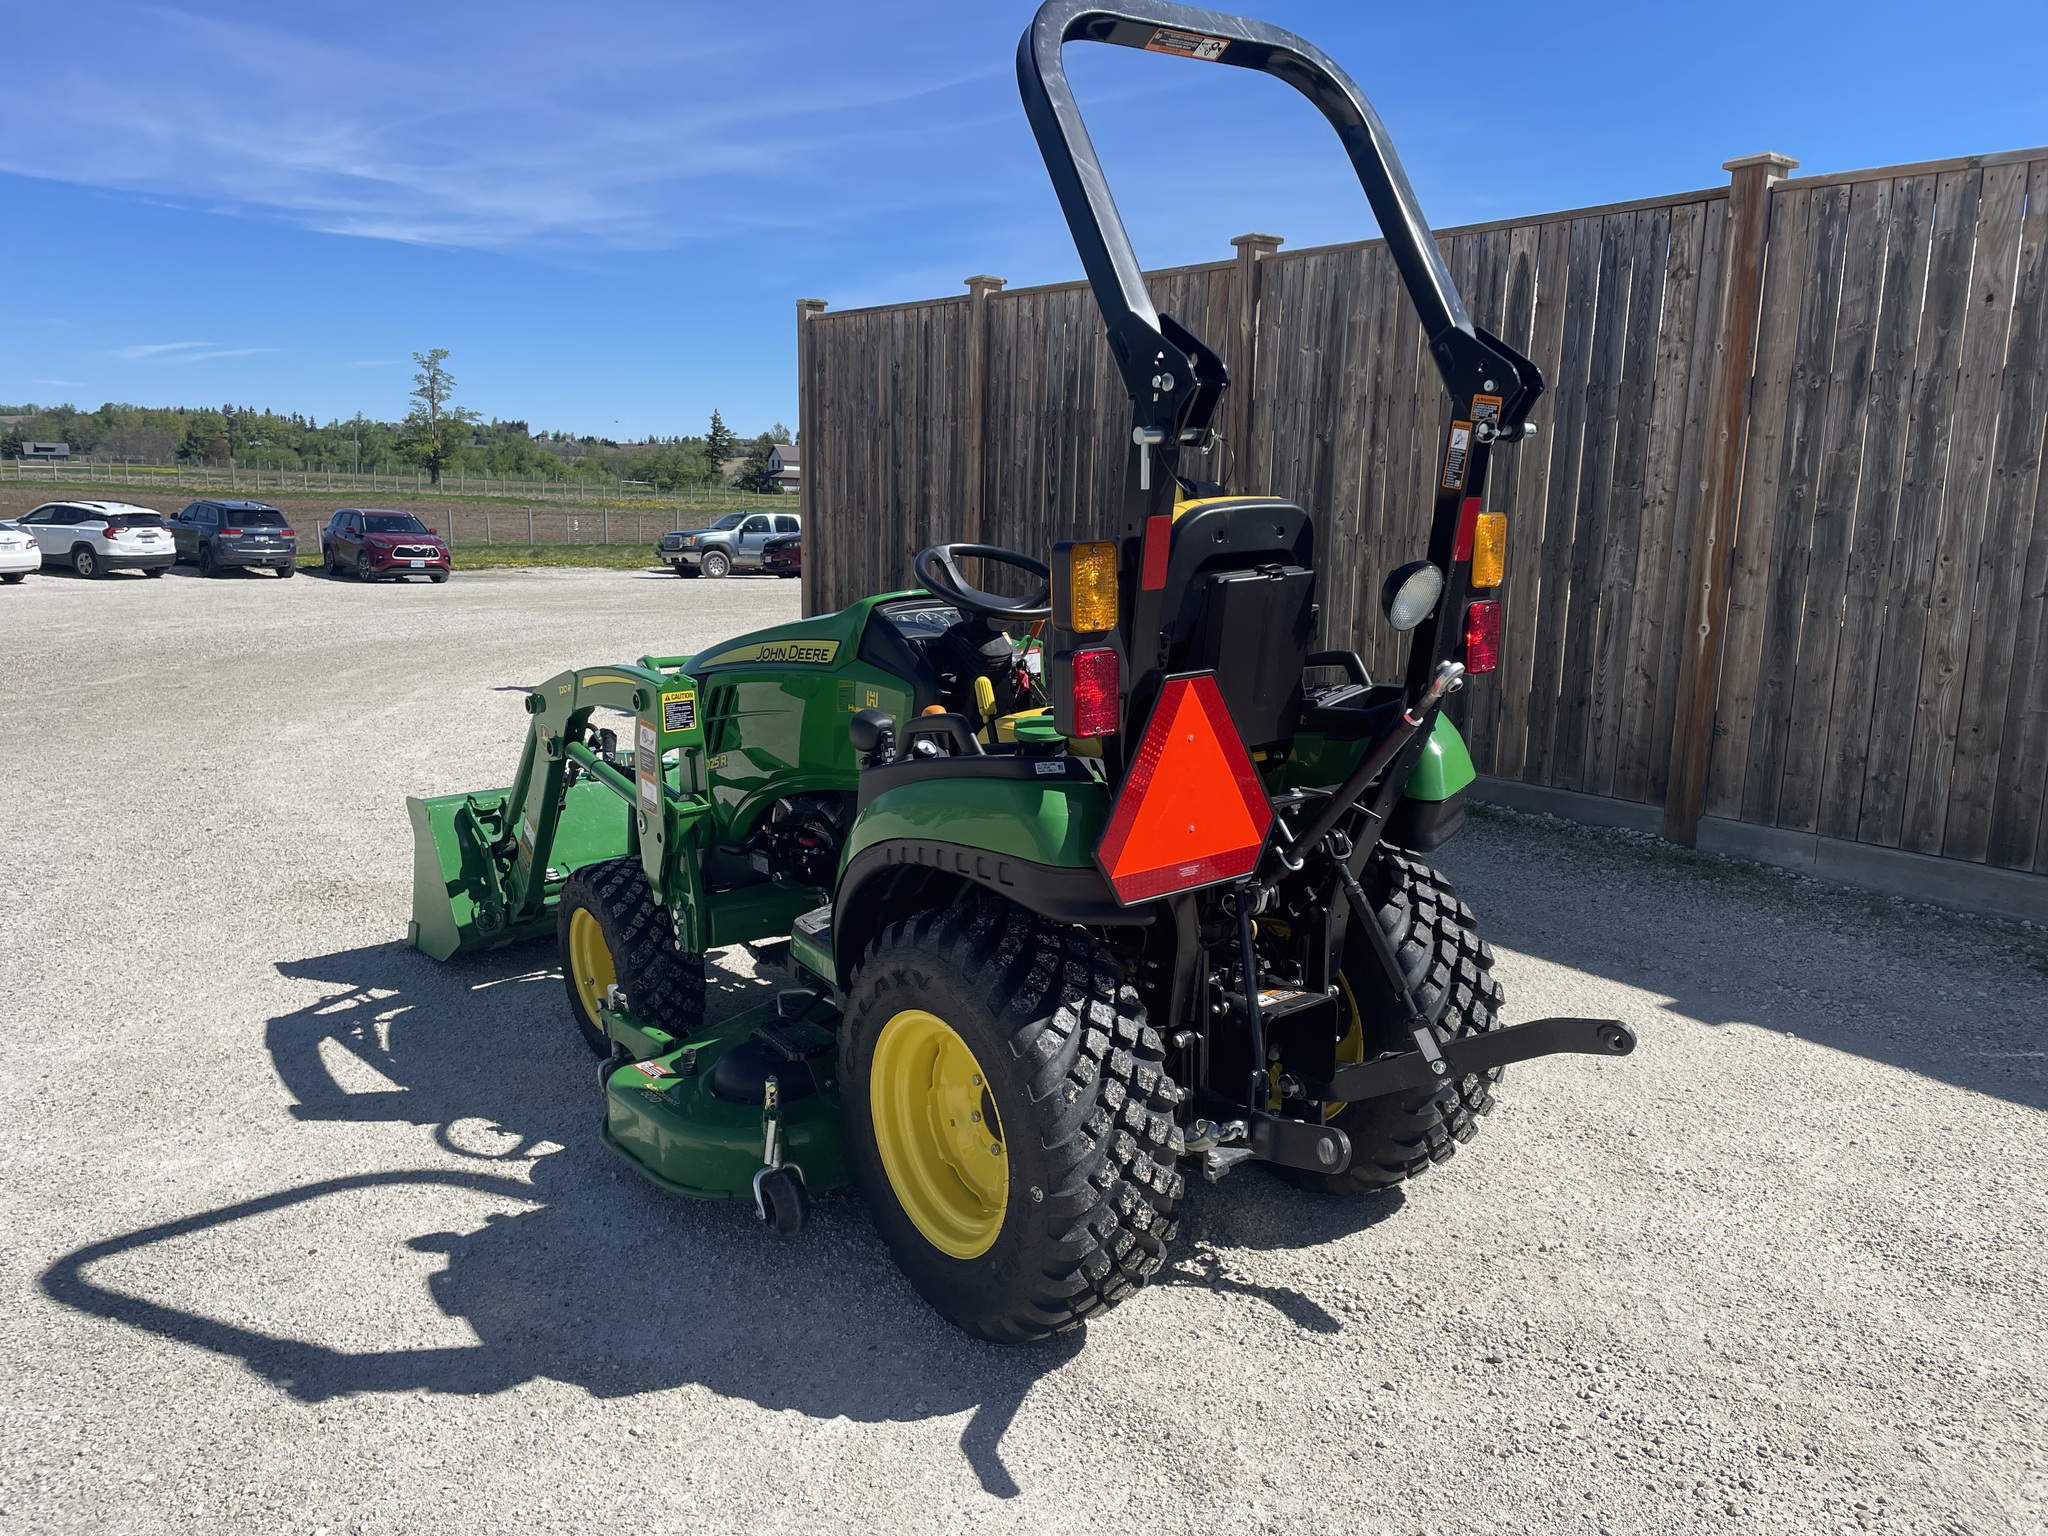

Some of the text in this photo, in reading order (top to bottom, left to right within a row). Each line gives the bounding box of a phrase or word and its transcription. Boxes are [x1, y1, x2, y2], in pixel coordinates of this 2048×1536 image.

[756, 645, 829, 661] JOHN DEERE
[670, 692, 693, 701] CAUTION
